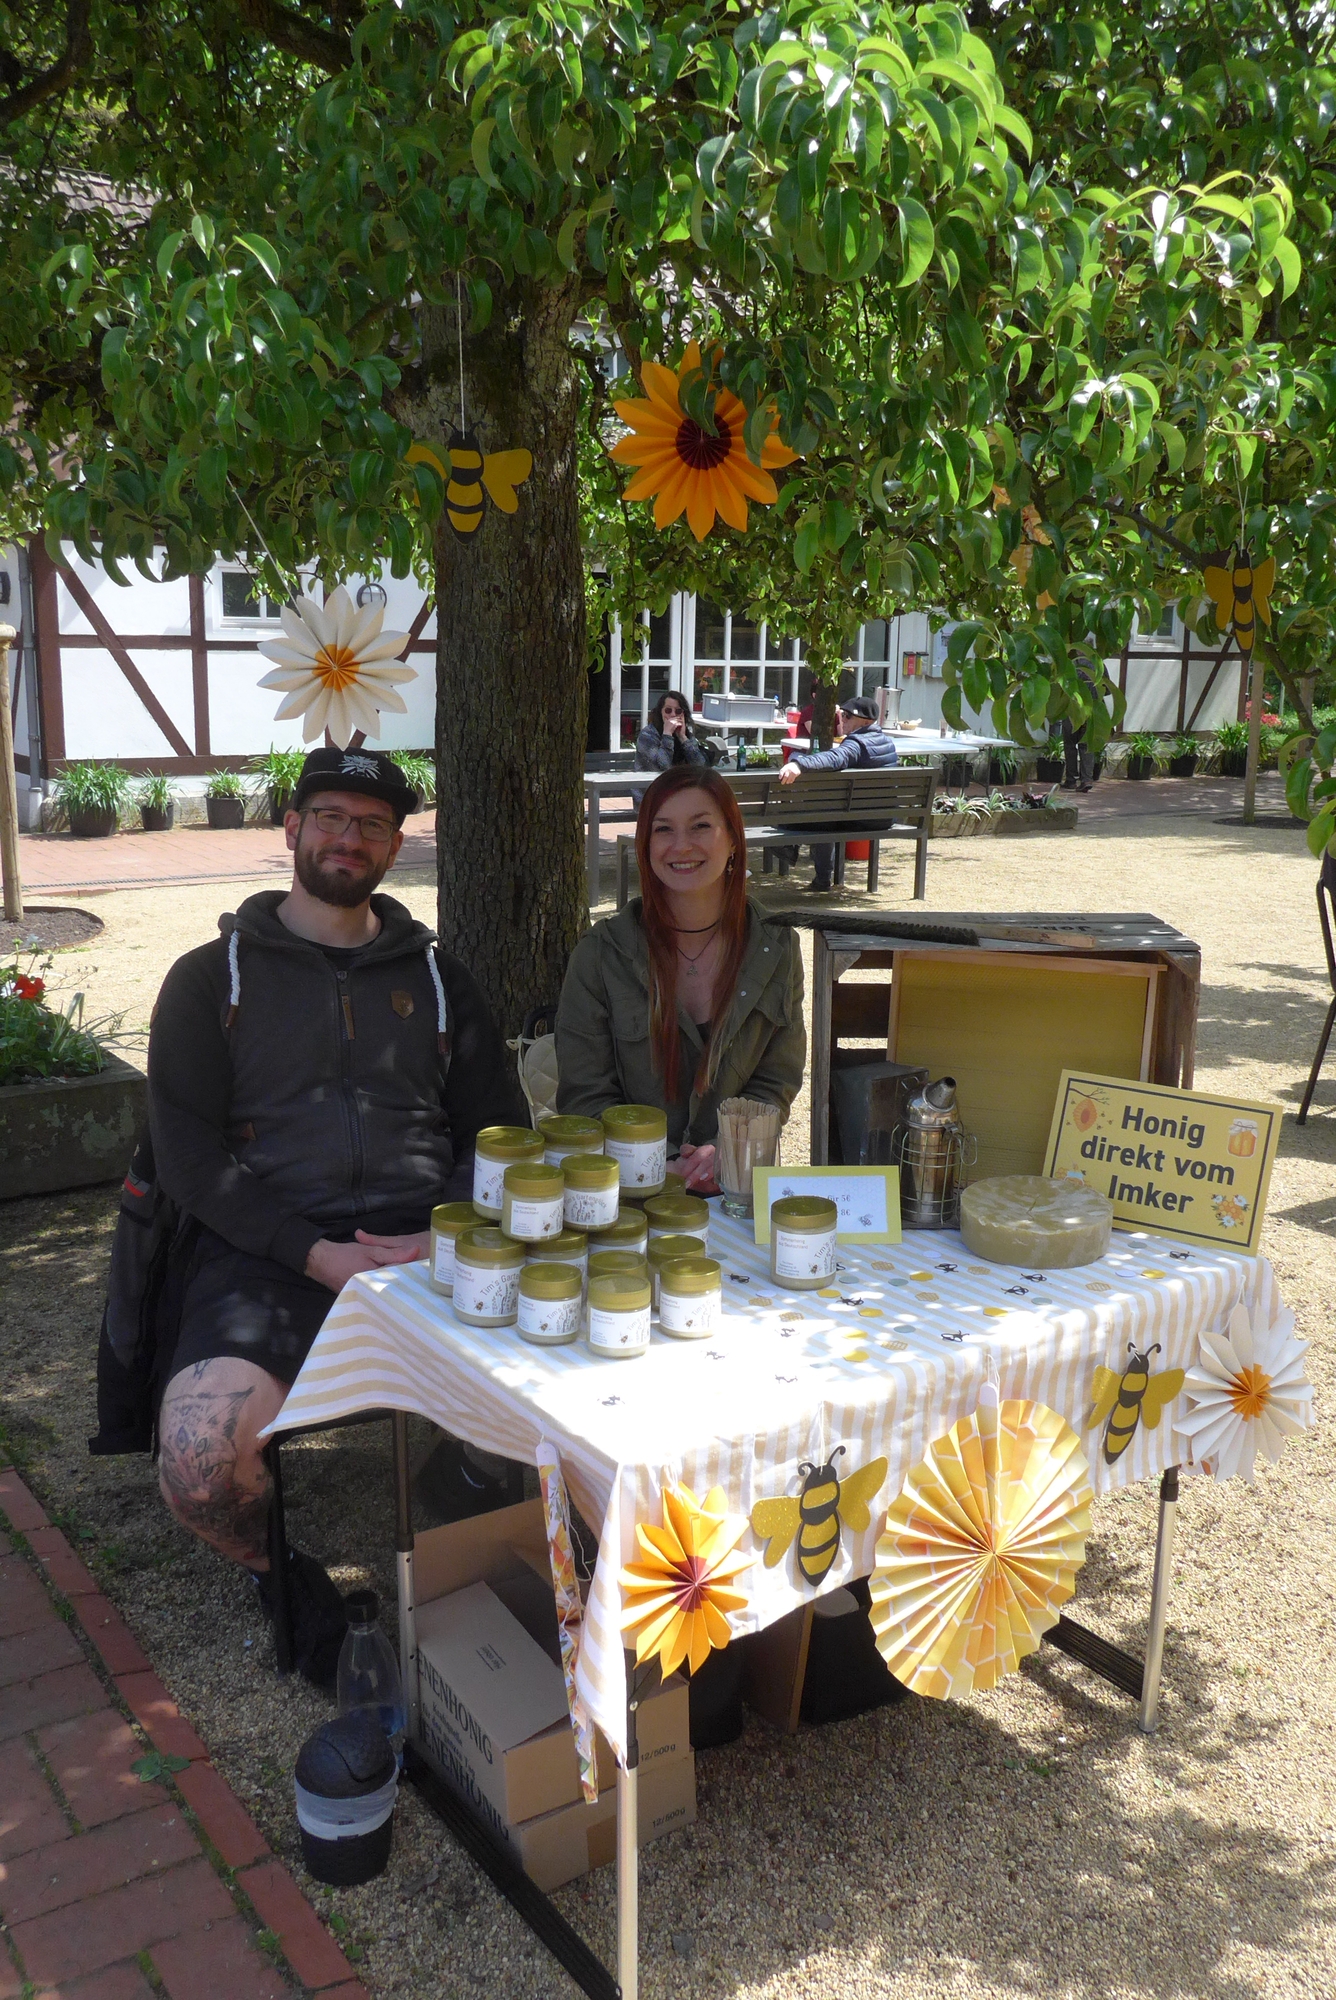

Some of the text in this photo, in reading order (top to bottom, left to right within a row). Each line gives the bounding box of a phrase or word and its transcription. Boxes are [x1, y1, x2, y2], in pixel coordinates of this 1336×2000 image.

[1121, 1105, 1205, 1148] Honig
[641, 1151, 657, 1168] Tim's
[1080, 1135, 1235, 1186] direkt vom
[1108, 1175, 1194, 1213] Imker
[814, 1241, 830, 1258] Tim's
[480, 1280, 500, 1296] Tim's
[546, 1308, 562, 1320] Tim's
[418, 1650, 493, 1765] ENENHONIG
